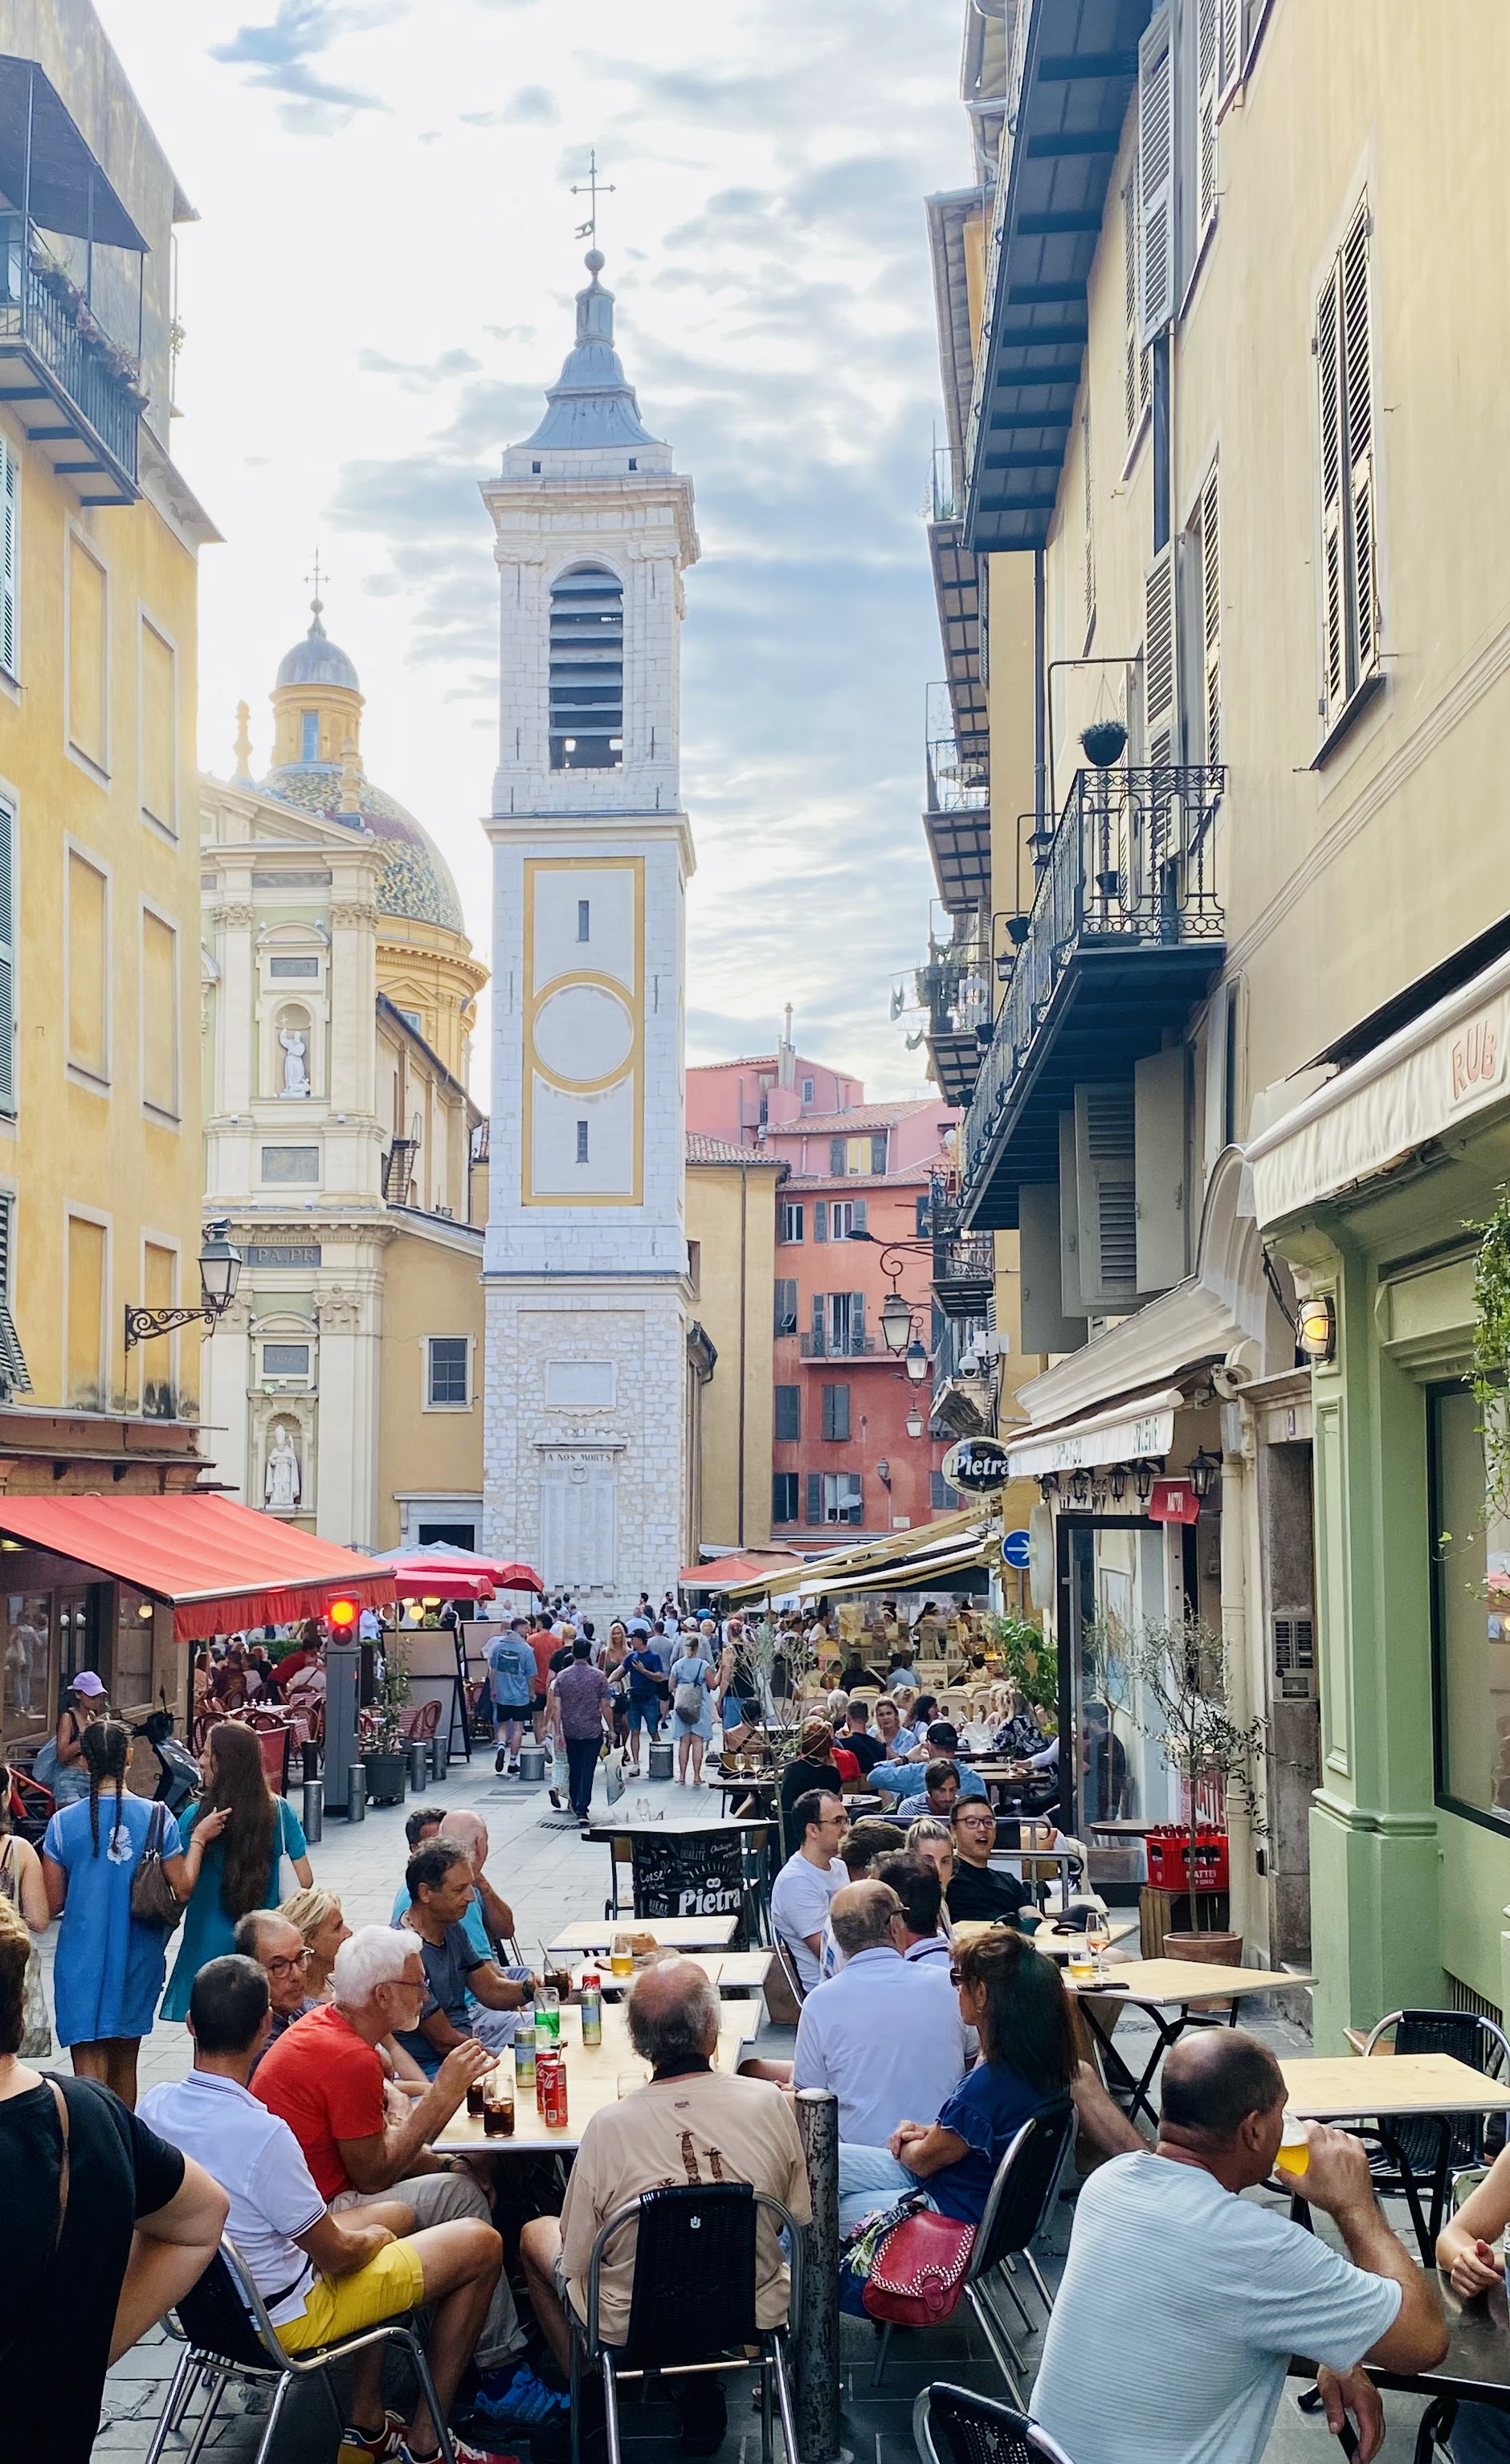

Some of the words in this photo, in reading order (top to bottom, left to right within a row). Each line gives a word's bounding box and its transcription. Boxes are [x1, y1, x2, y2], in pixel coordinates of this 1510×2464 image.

[547, 1454, 553, 1462] A
[557, 1454, 576, 1462] NOS
[579, 1454, 611, 1462] MORTS
[950, 1454, 1010, 1478] Pietra
[677, 1887, 741, 1916] Pietra
